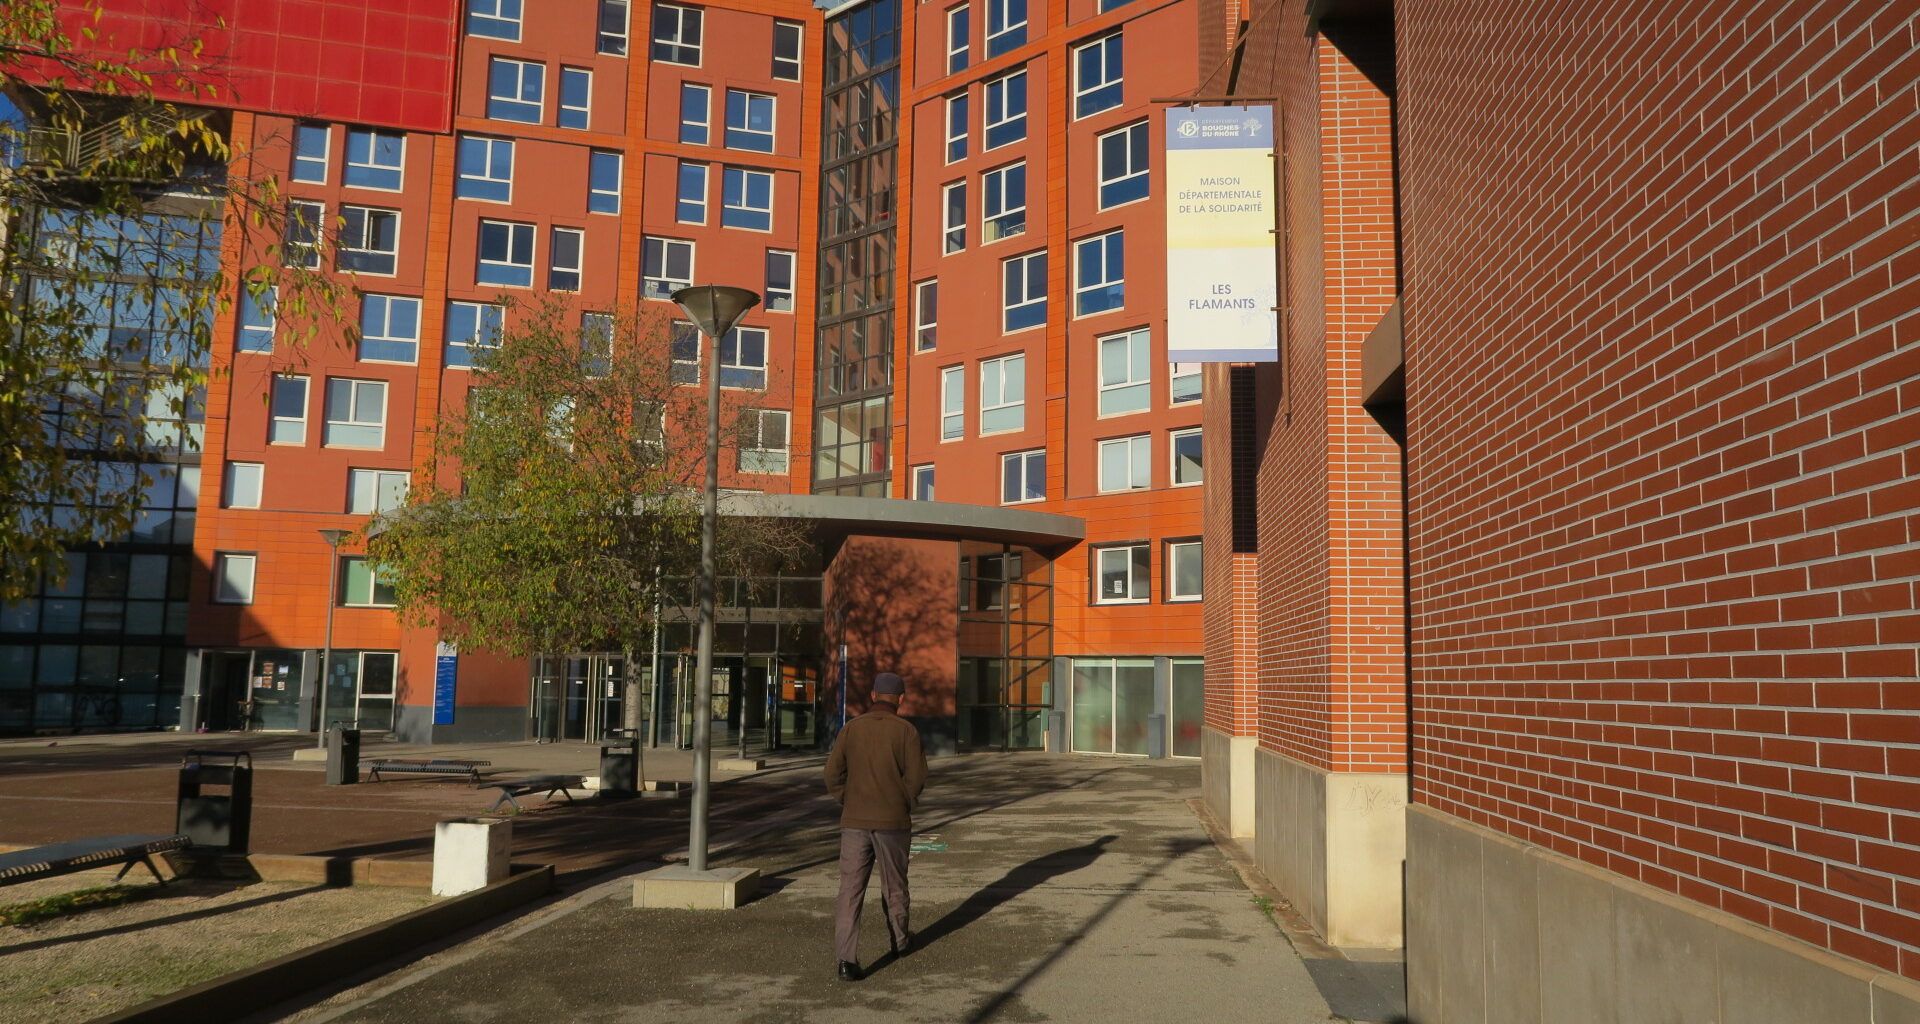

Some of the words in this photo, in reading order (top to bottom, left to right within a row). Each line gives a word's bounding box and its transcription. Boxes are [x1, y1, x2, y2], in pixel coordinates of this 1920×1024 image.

[1200, 177, 1240, 186] MAISON
[1179, 190, 1262, 200] DÉPARTEMENTALE
[1179, 205, 1191, 213] DE
[1194, 205, 1206, 213] LA
[1208, 202, 1262, 213] SOLIDARITÉ
[1212, 284, 1232, 295] LES
[1189, 298, 1255, 310] FLAMANTS
